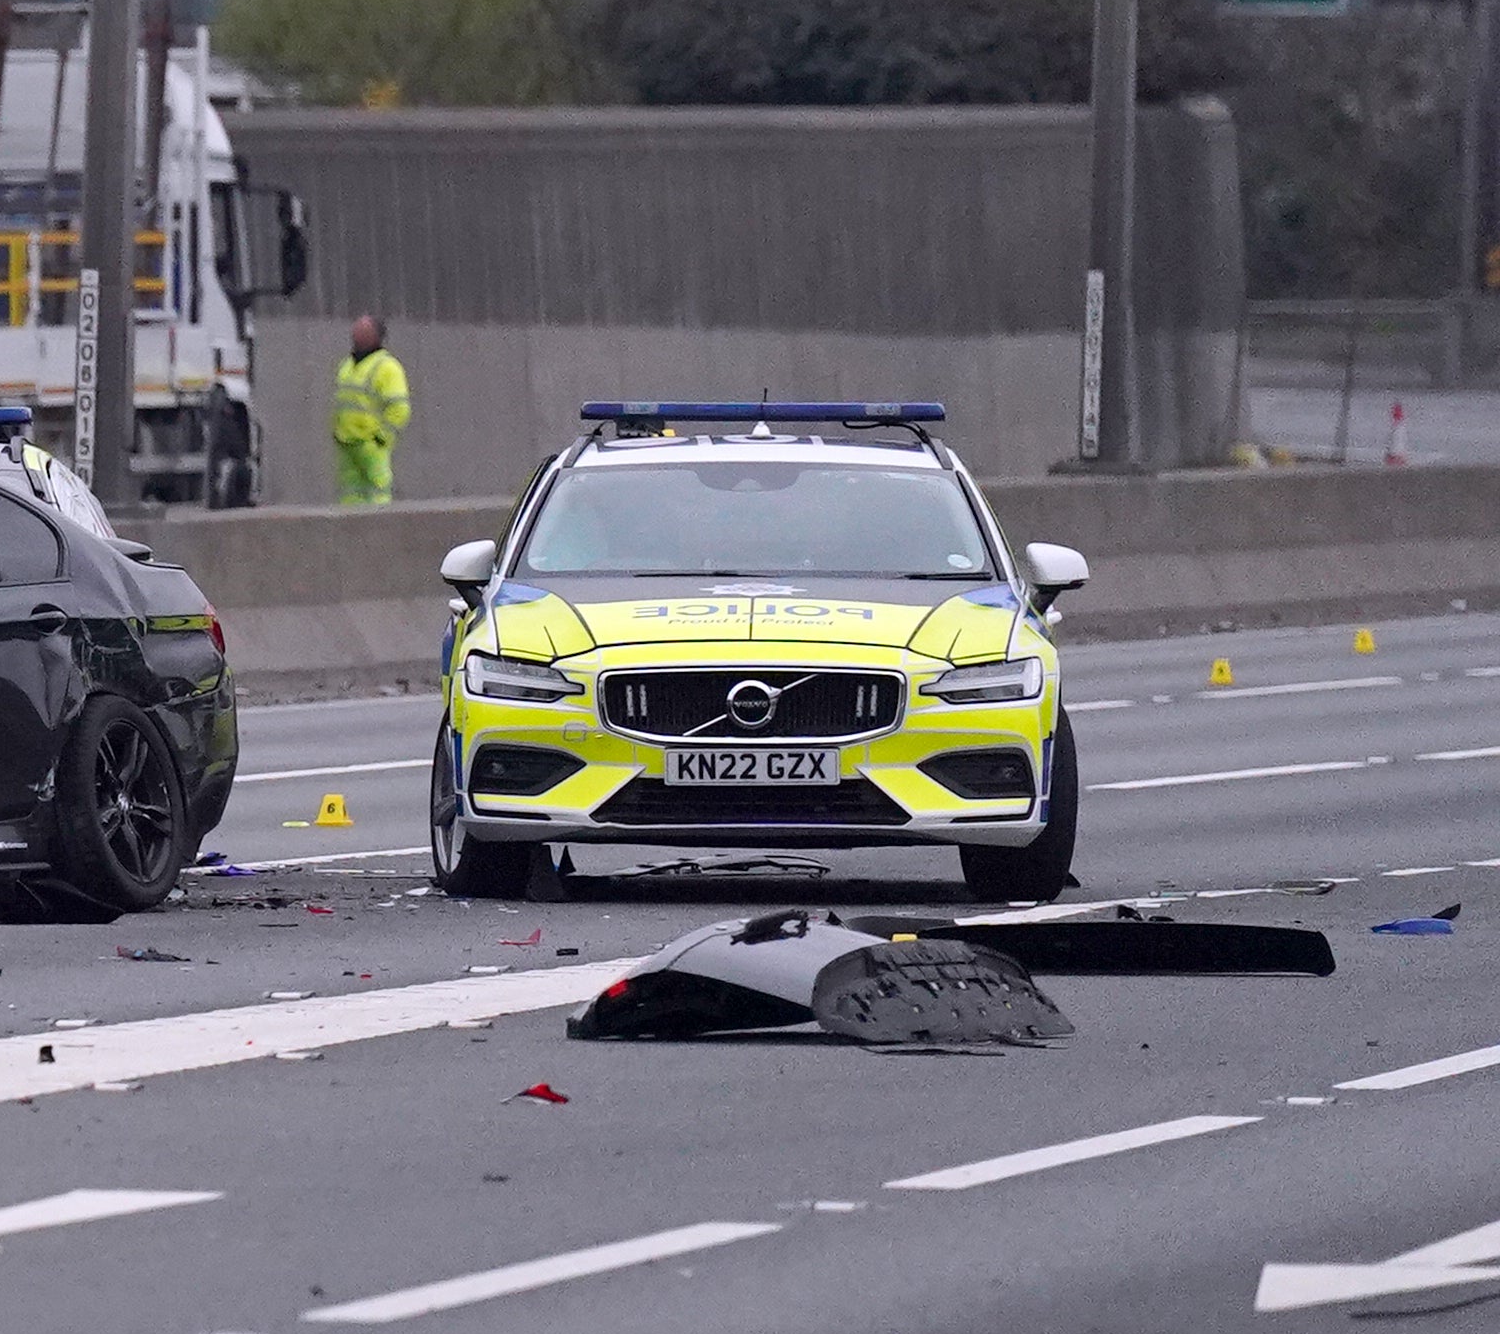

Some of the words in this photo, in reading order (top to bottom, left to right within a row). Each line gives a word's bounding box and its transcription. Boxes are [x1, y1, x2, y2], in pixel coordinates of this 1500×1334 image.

[677, 752, 757, 780] KN22
[766, 752, 827, 780] GZX
[327, 802, 336, 814] 6
